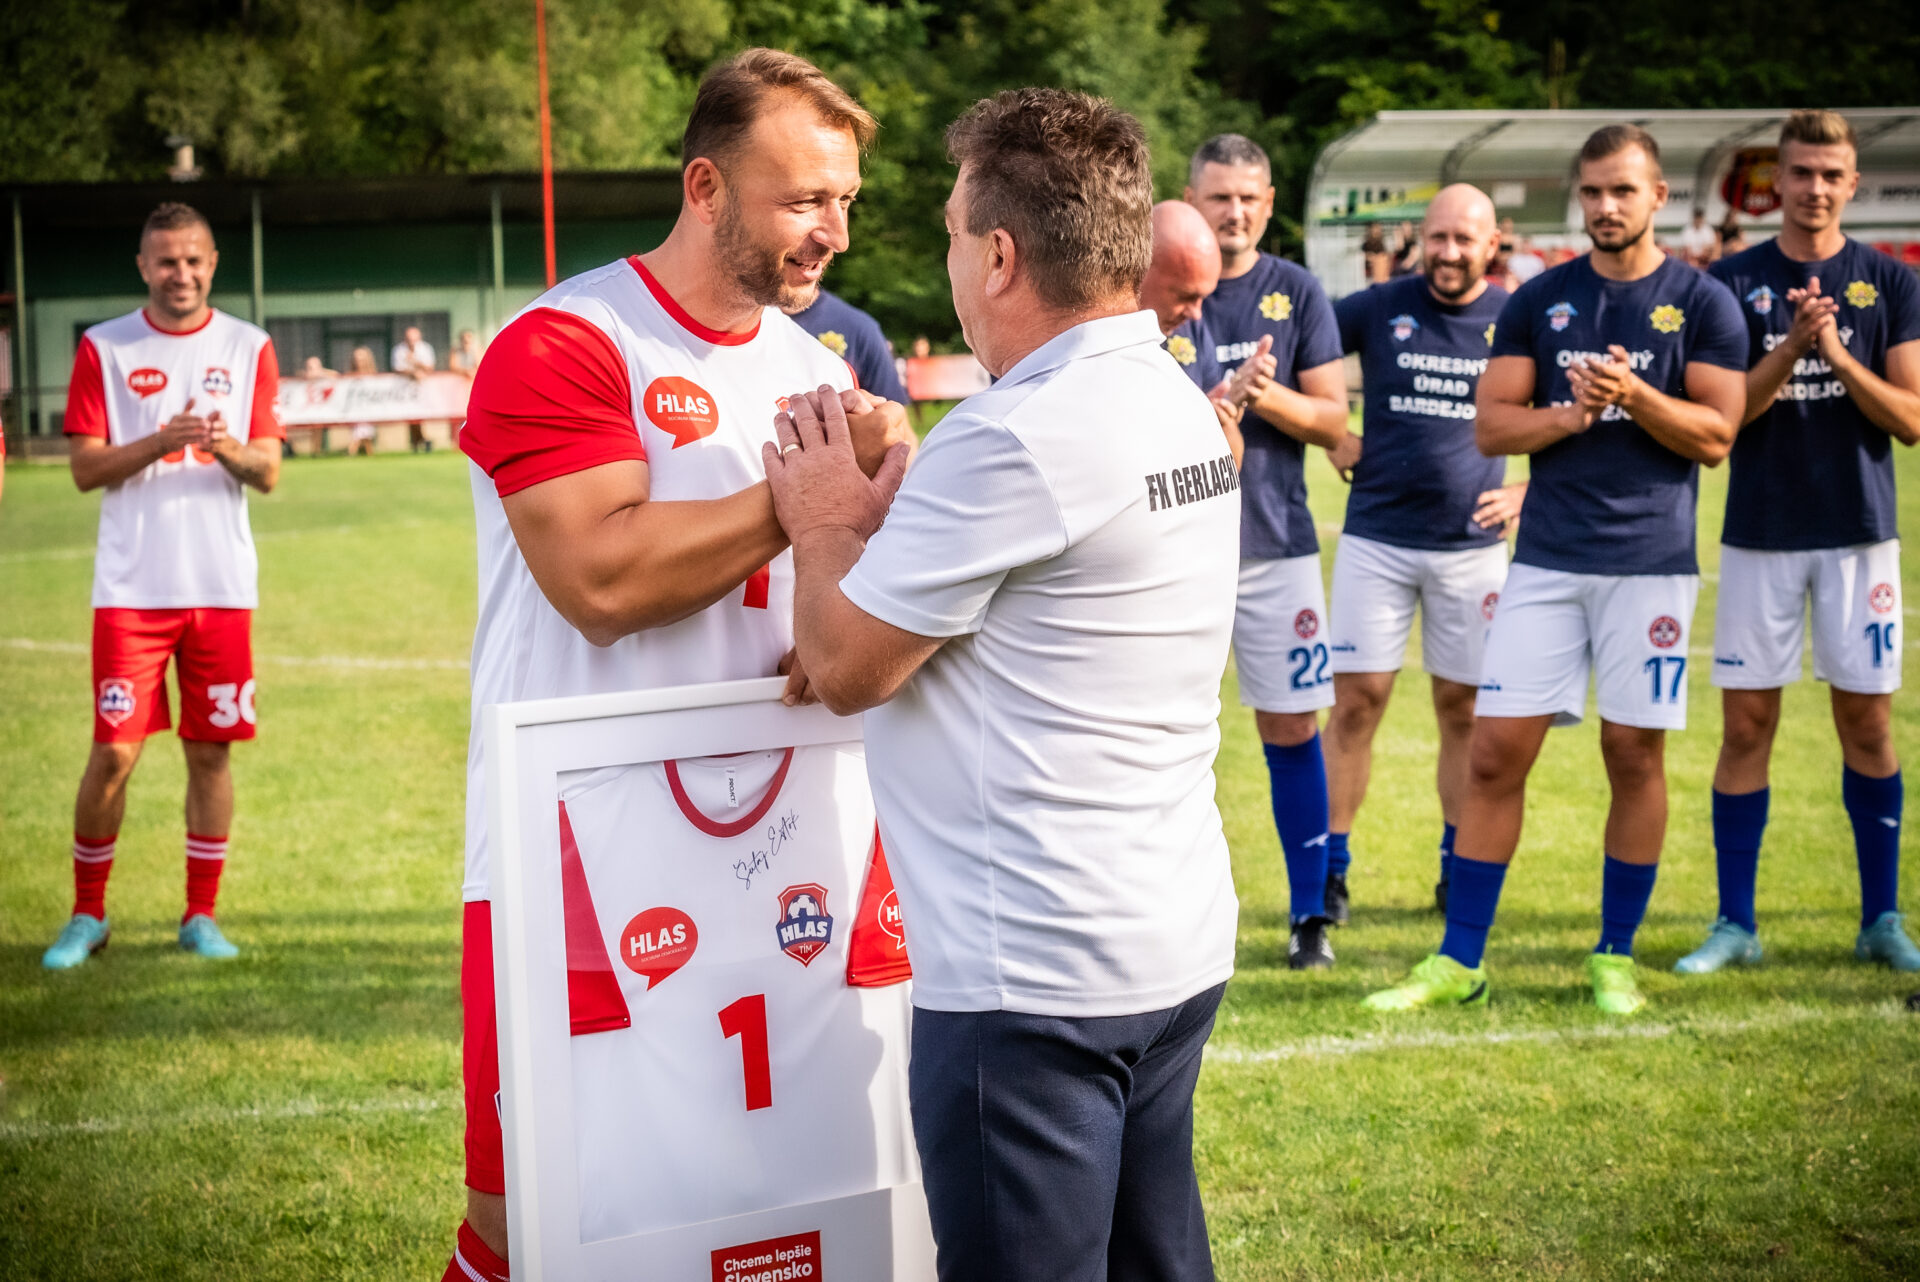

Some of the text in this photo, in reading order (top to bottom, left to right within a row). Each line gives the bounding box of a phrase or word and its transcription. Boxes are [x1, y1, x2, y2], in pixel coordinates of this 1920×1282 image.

[1413, 374, 1470, 397] ÚRAD
[656, 393, 710, 415] HLAS
[1389, 395, 1477, 420] BARDEJO
[1144, 453, 1240, 512] FK GERLACH
[1289, 643, 1334, 692] 22
[1645, 656, 1687, 704] 17
[629, 923, 687, 957] HLAS
[780, 920, 828, 944] HLAS
[799, 943, 813, 954] TÍM
[718, 994, 772, 1112] 1
[723, 1244, 812, 1273] Chceme lepšie
